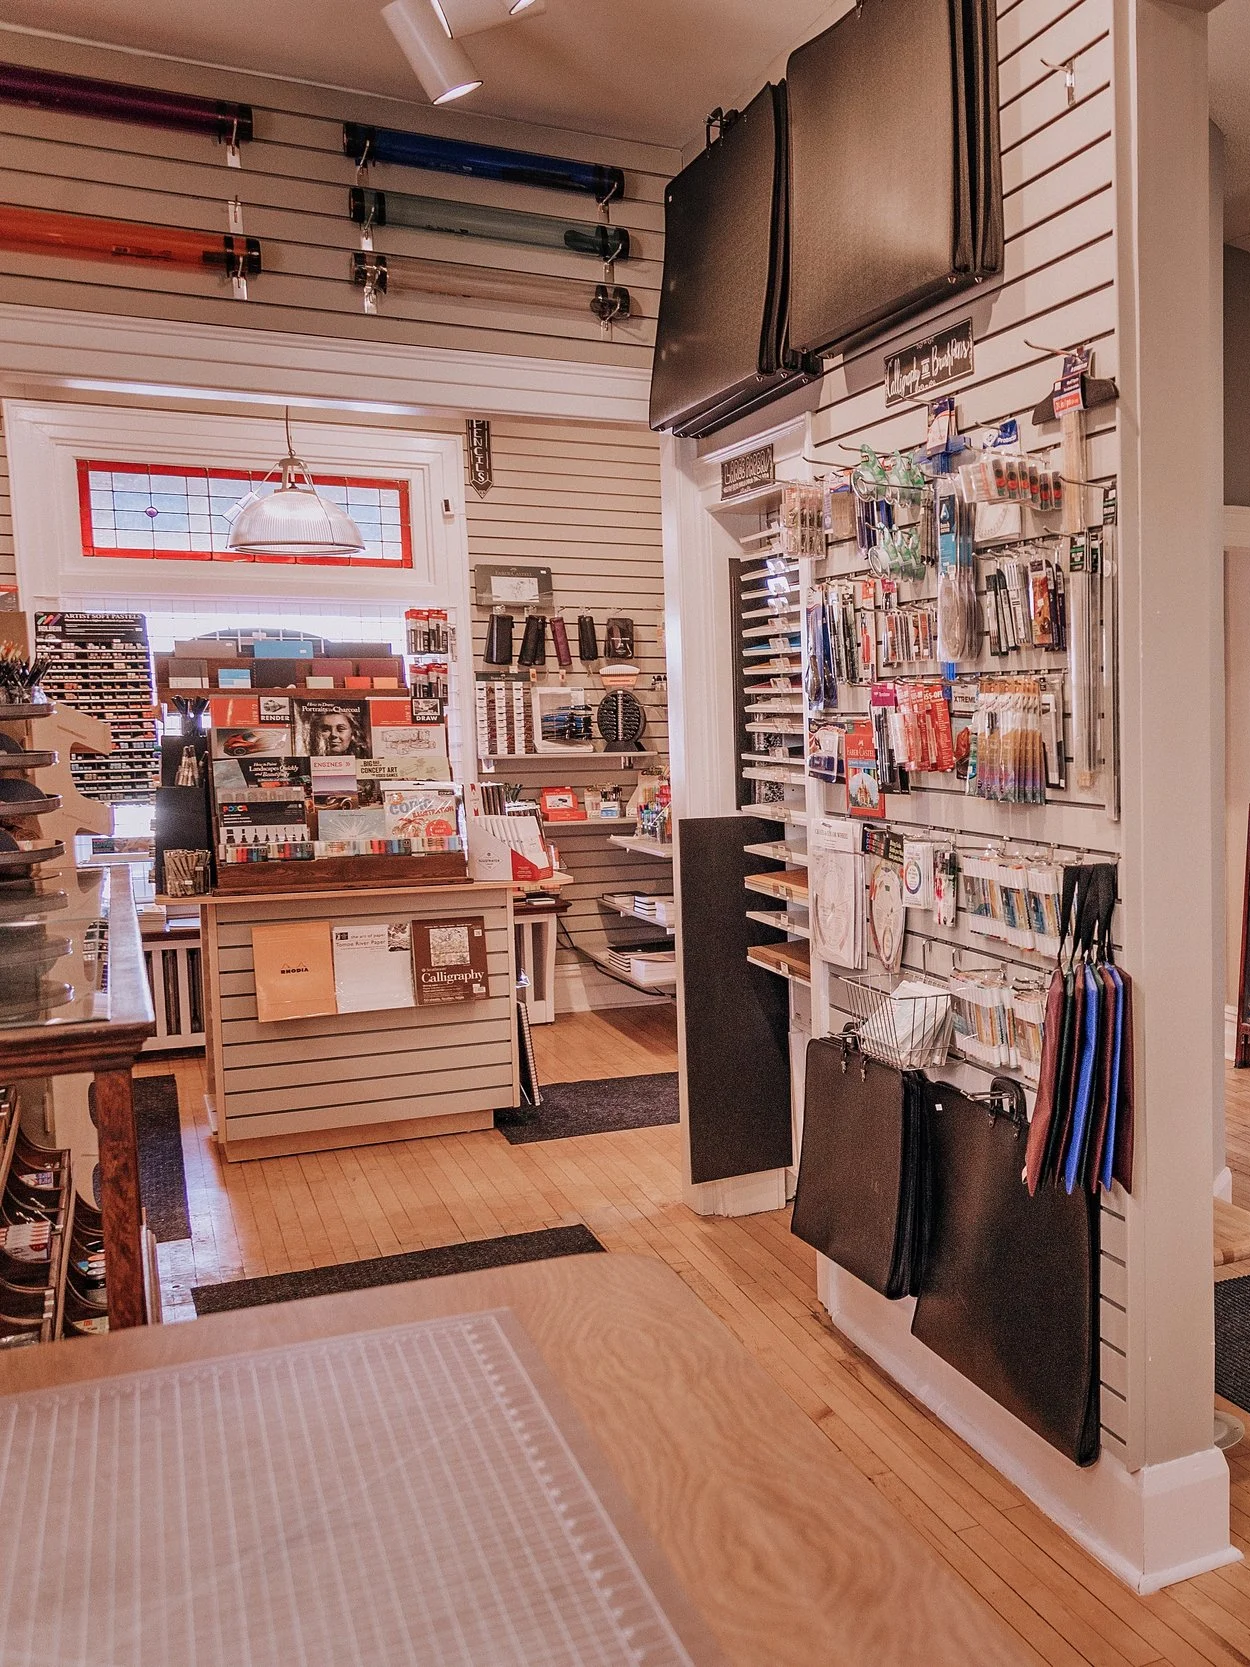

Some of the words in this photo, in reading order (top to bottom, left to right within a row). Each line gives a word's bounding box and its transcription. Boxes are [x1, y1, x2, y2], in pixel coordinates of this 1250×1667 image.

[473, 420, 484, 482] PENCILS
[302, 704, 327, 712] Portraits
[223, 805, 248, 813] POSCA
[412, 806, 454, 819] ILLUSTRATION
[422, 969, 484, 984] Calligraphy
